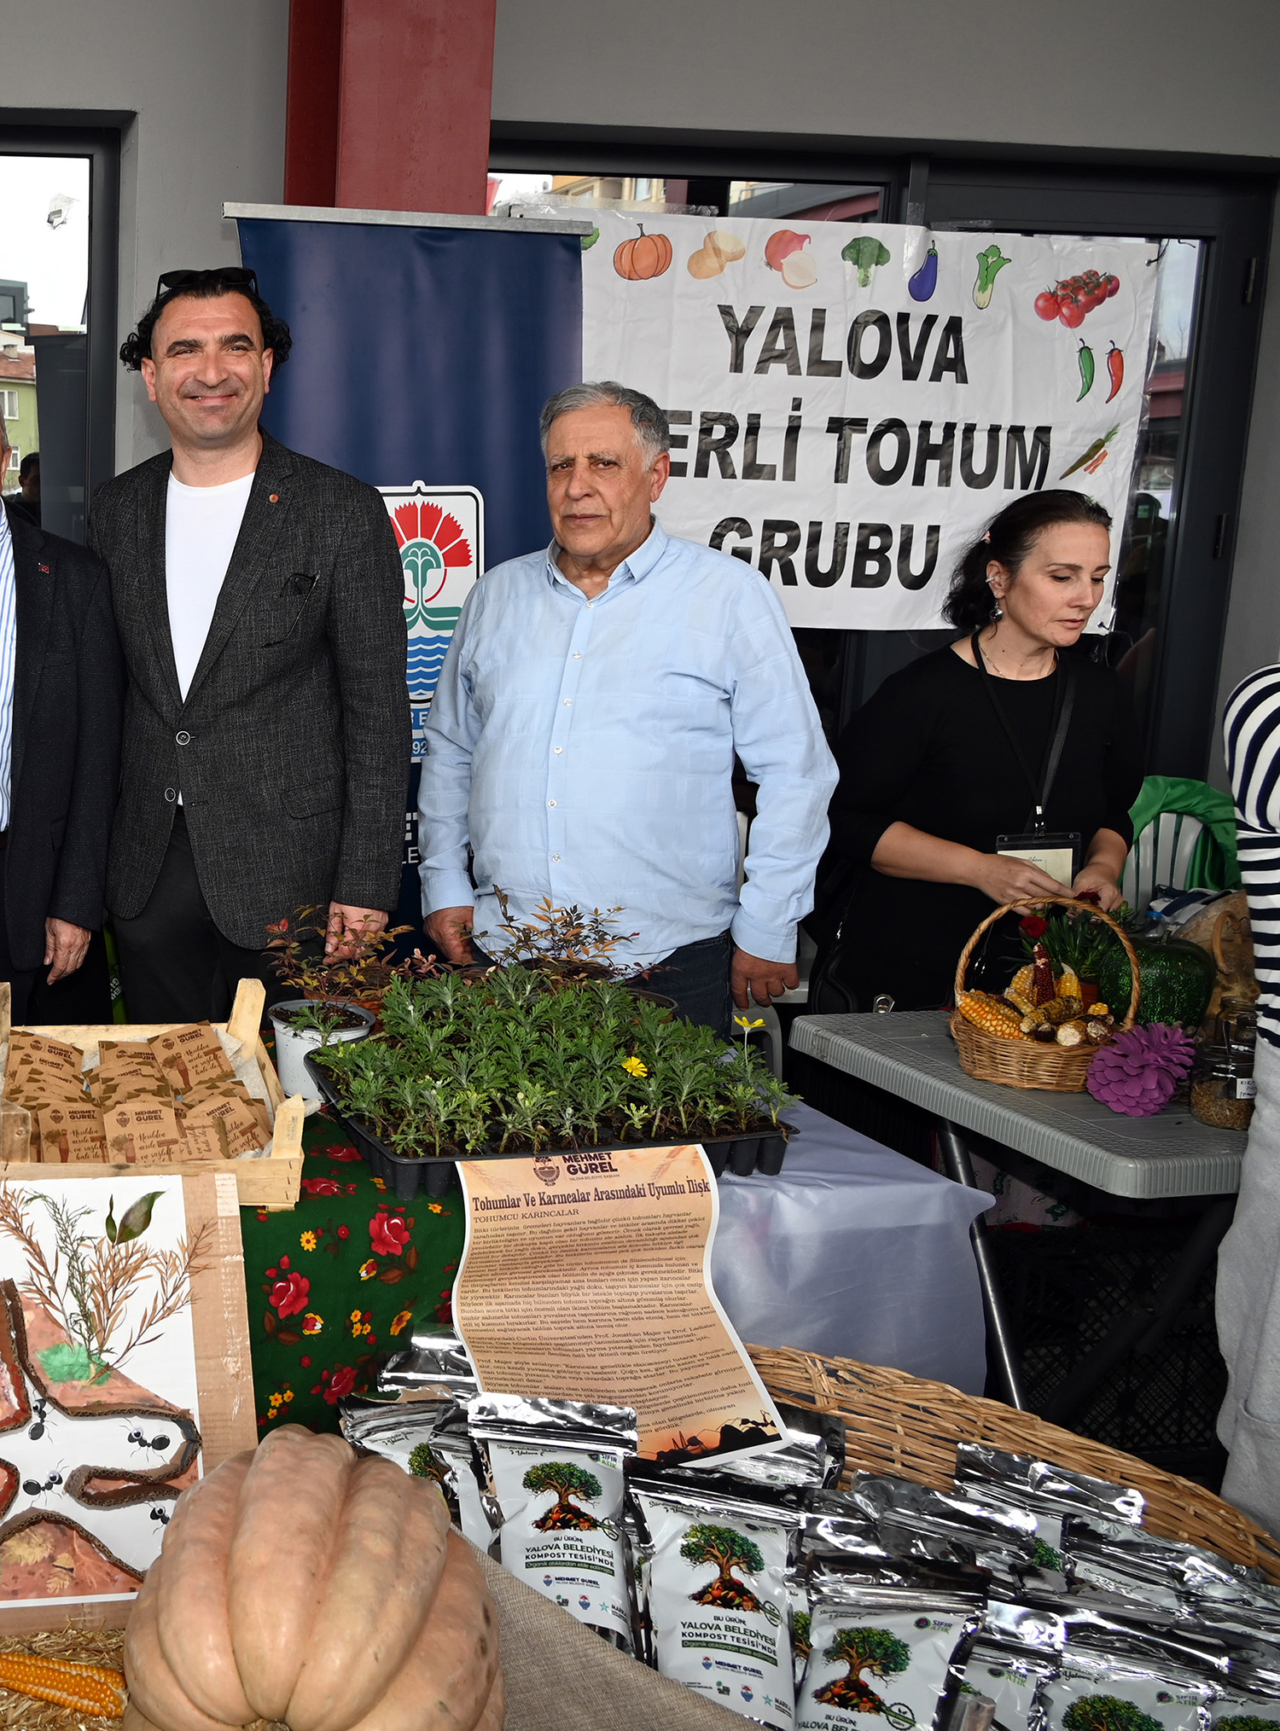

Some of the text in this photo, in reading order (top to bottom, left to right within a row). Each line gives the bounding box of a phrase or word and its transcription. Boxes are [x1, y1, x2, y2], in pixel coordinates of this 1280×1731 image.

[717, 304, 968, 384] YALOVA
[664, 397, 1052, 491] ERLİ TOHUM
[708, 516, 941, 591] GRUBU
[562, 1152, 612, 1163] MEHMET
[472, 1195, 521, 1212] Tohumlar
[523, 1193, 537, 1207] Ve
[538, 1189, 591, 1206] Karıncalar
[594, 1184, 647, 1202] Arasındaki
[648, 1181, 685, 1199] Uyumlu
[473, 1208, 579, 1223] TOHUMCU KARINCALAR
[525, 1543, 614, 1559] YALOVA BELEDİYESİ
[525, 1552, 566, 1560] KOMPOST
[680, 1621, 776, 1646] YALOVA BELEDİYESİ
[681, 1631, 728, 1640] KOMPOST
